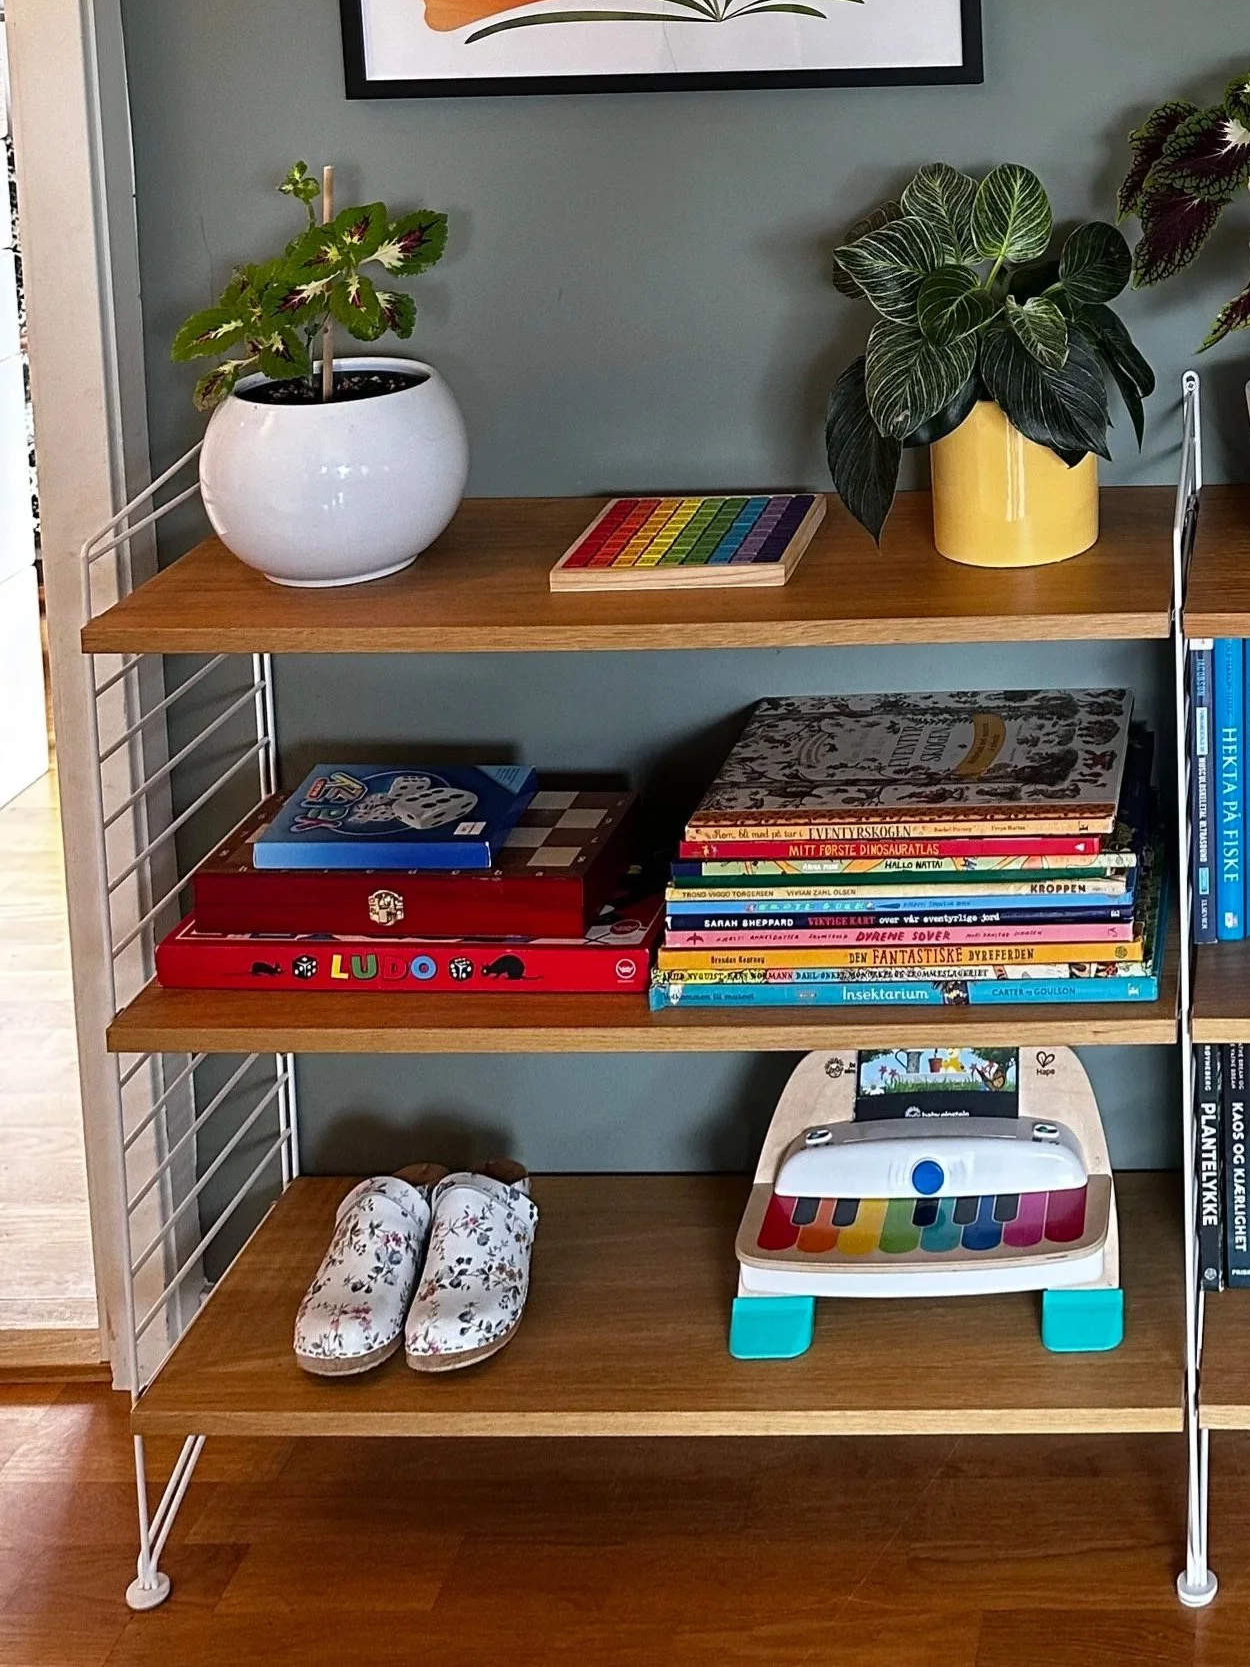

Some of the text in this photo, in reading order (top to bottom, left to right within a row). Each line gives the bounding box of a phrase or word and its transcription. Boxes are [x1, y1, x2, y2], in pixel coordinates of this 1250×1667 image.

[1222, 728, 1237, 794] HEKTA
[1223, 801, 1241, 825] PÅ
[752, 825, 911, 840] med på tur EVENTYRSKOGEN
[789, 842, 940, 857] MITT FØRSTE DINOSAURATLAS
[1223, 830, 1238, 883] FISKE
[884, 860, 943, 870] HALLO NATTA!
[1030, 884, 1086, 893] KROPPEN
[704, 912, 1000, 928] SARAH SHEPPARD VIKTIGE KART over vår eventyrlige jord
[856, 930, 951, 942] DYRENE SOVER
[711, 947, 1034, 965] Brendan Kearney DEN FANTASTISKE DYREFERDEN
[330, 954, 437, 980] LUDO
[842, 987, 1075, 1001] Insektarium CARTER GOULSON
[1200, 1103, 1217, 1226] PLANTELYKKE
[1232, 1102, 1247, 1251] KAOS OG KJÆRLIGHET
